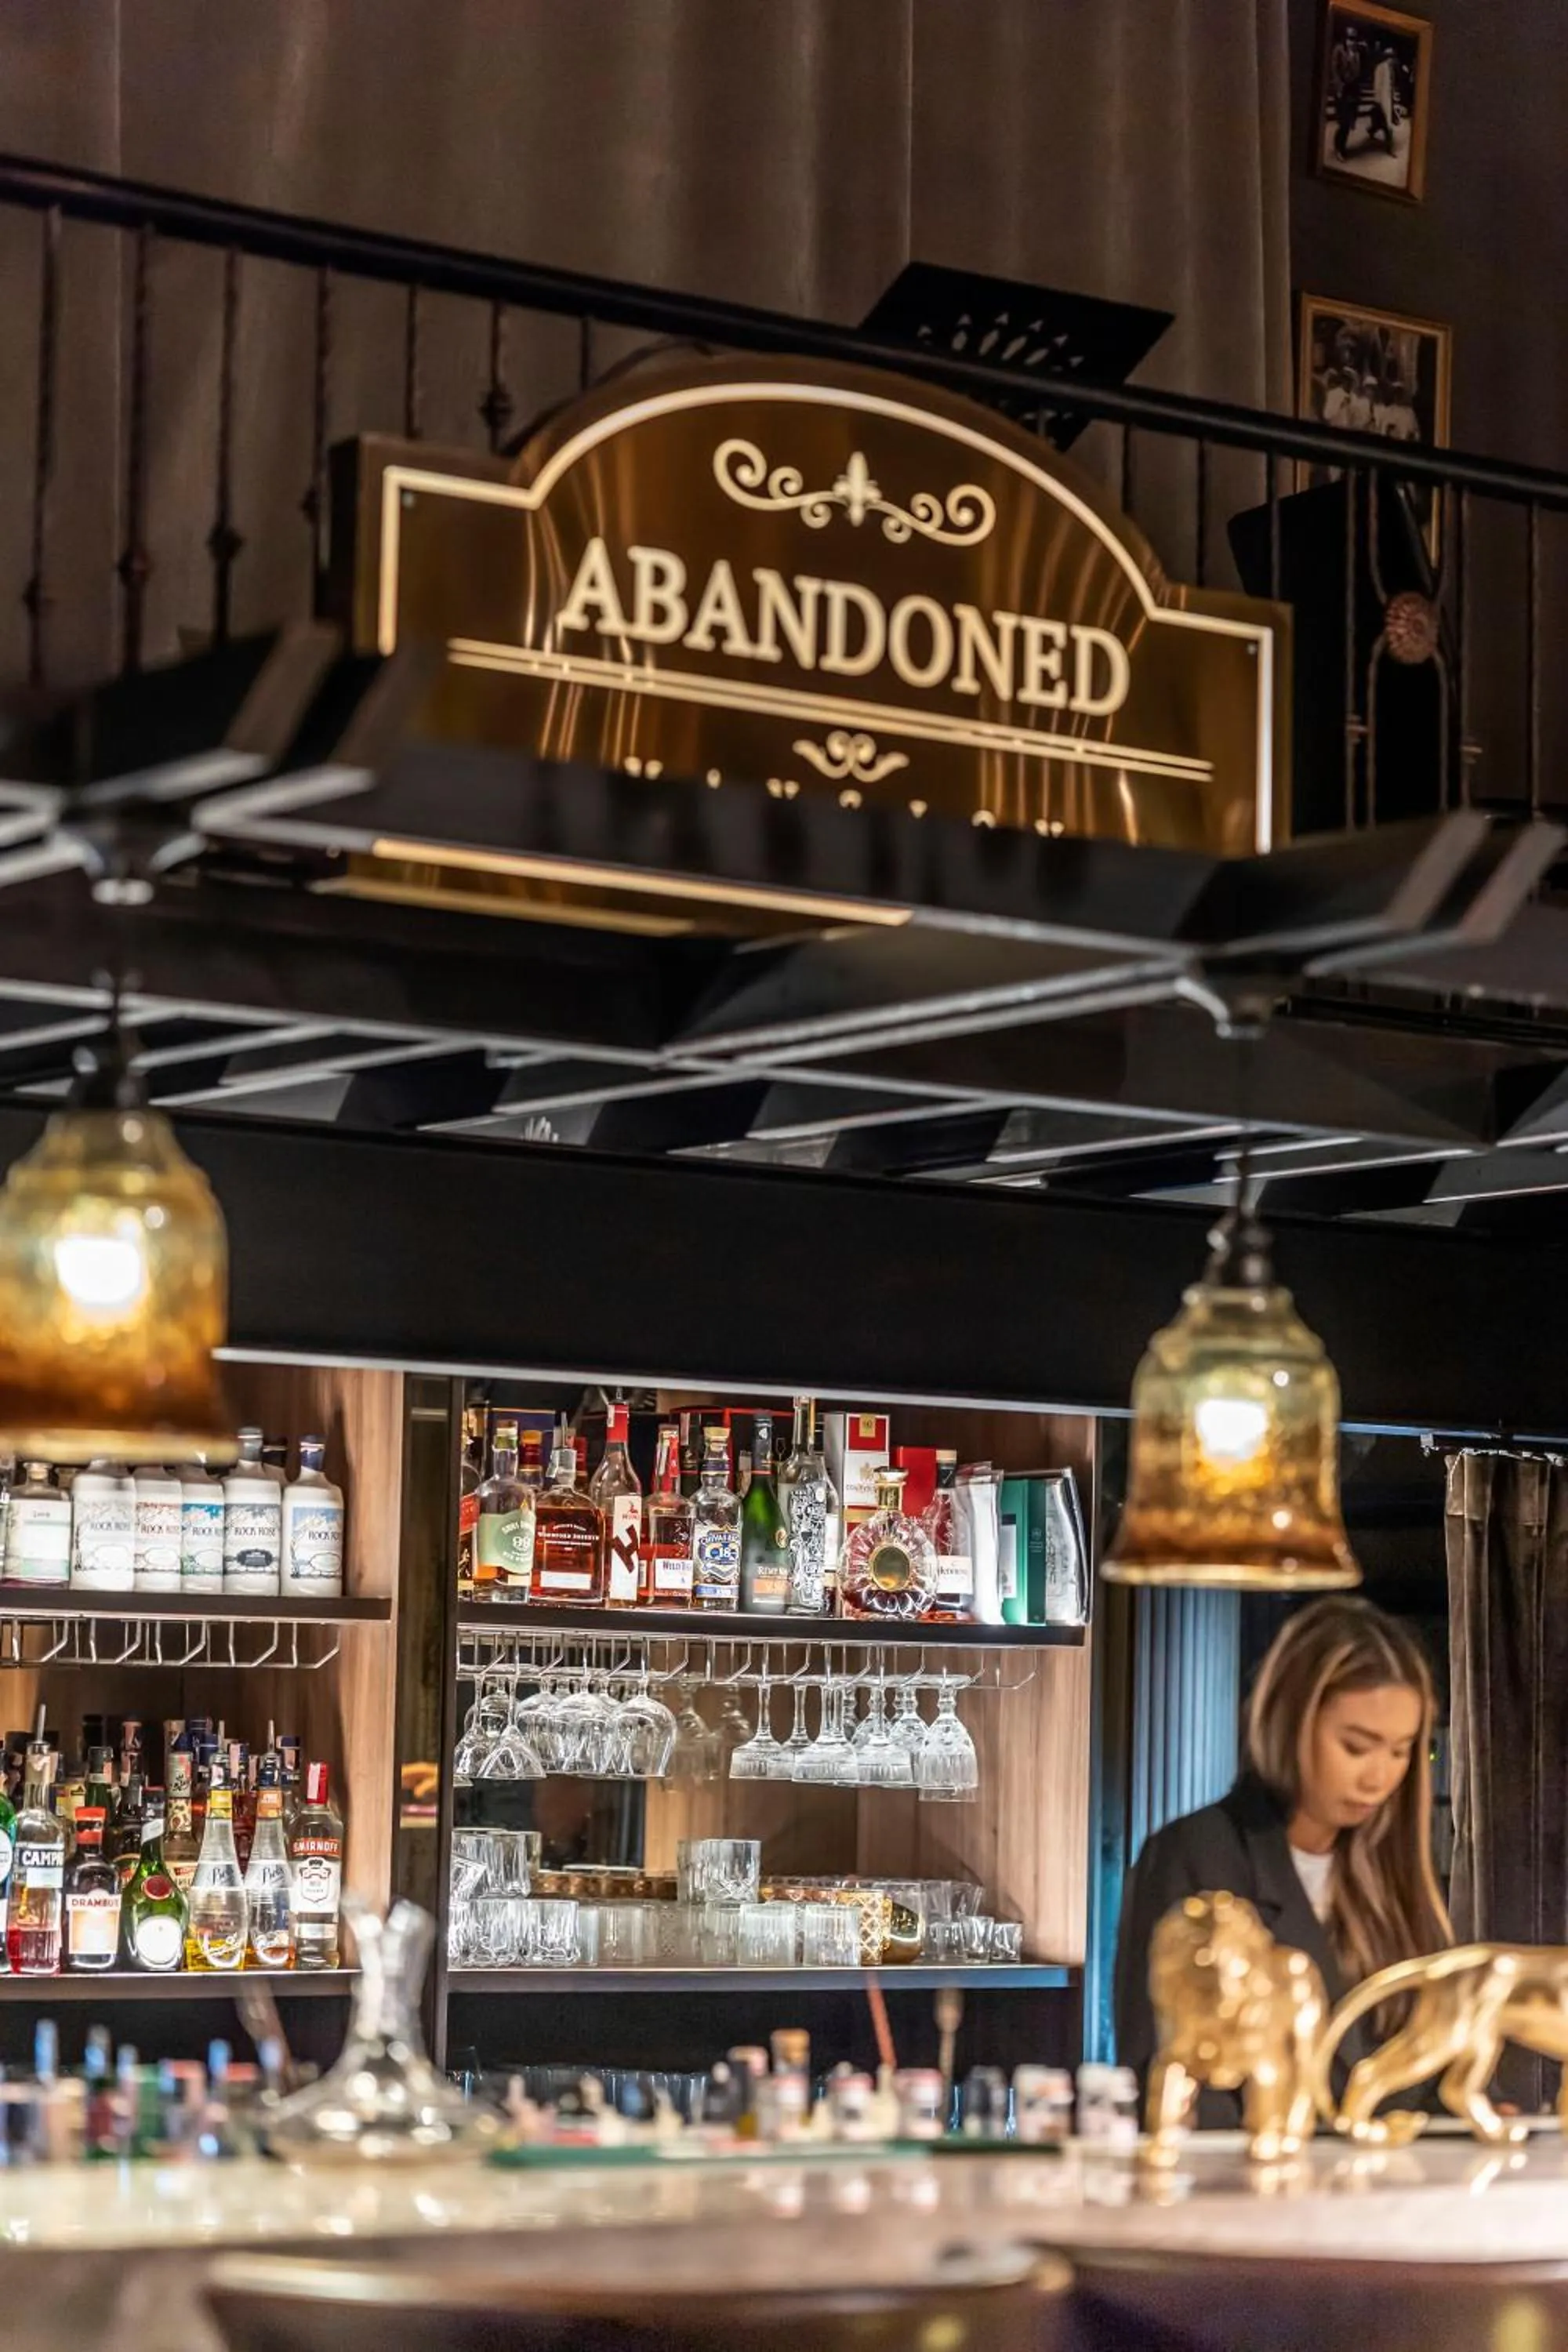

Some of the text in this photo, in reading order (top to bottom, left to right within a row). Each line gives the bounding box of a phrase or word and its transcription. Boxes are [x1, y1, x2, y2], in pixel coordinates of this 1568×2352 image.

[557, 537, 1131, 717] ABANDONED
[140, 1524, 164, 1534] ROCK
[234, 1526, 256, 1537] ROCK
[308, 1530, 329, 1541] ROCK
[292, 1841, 339, 1853] SMIRNOFF
